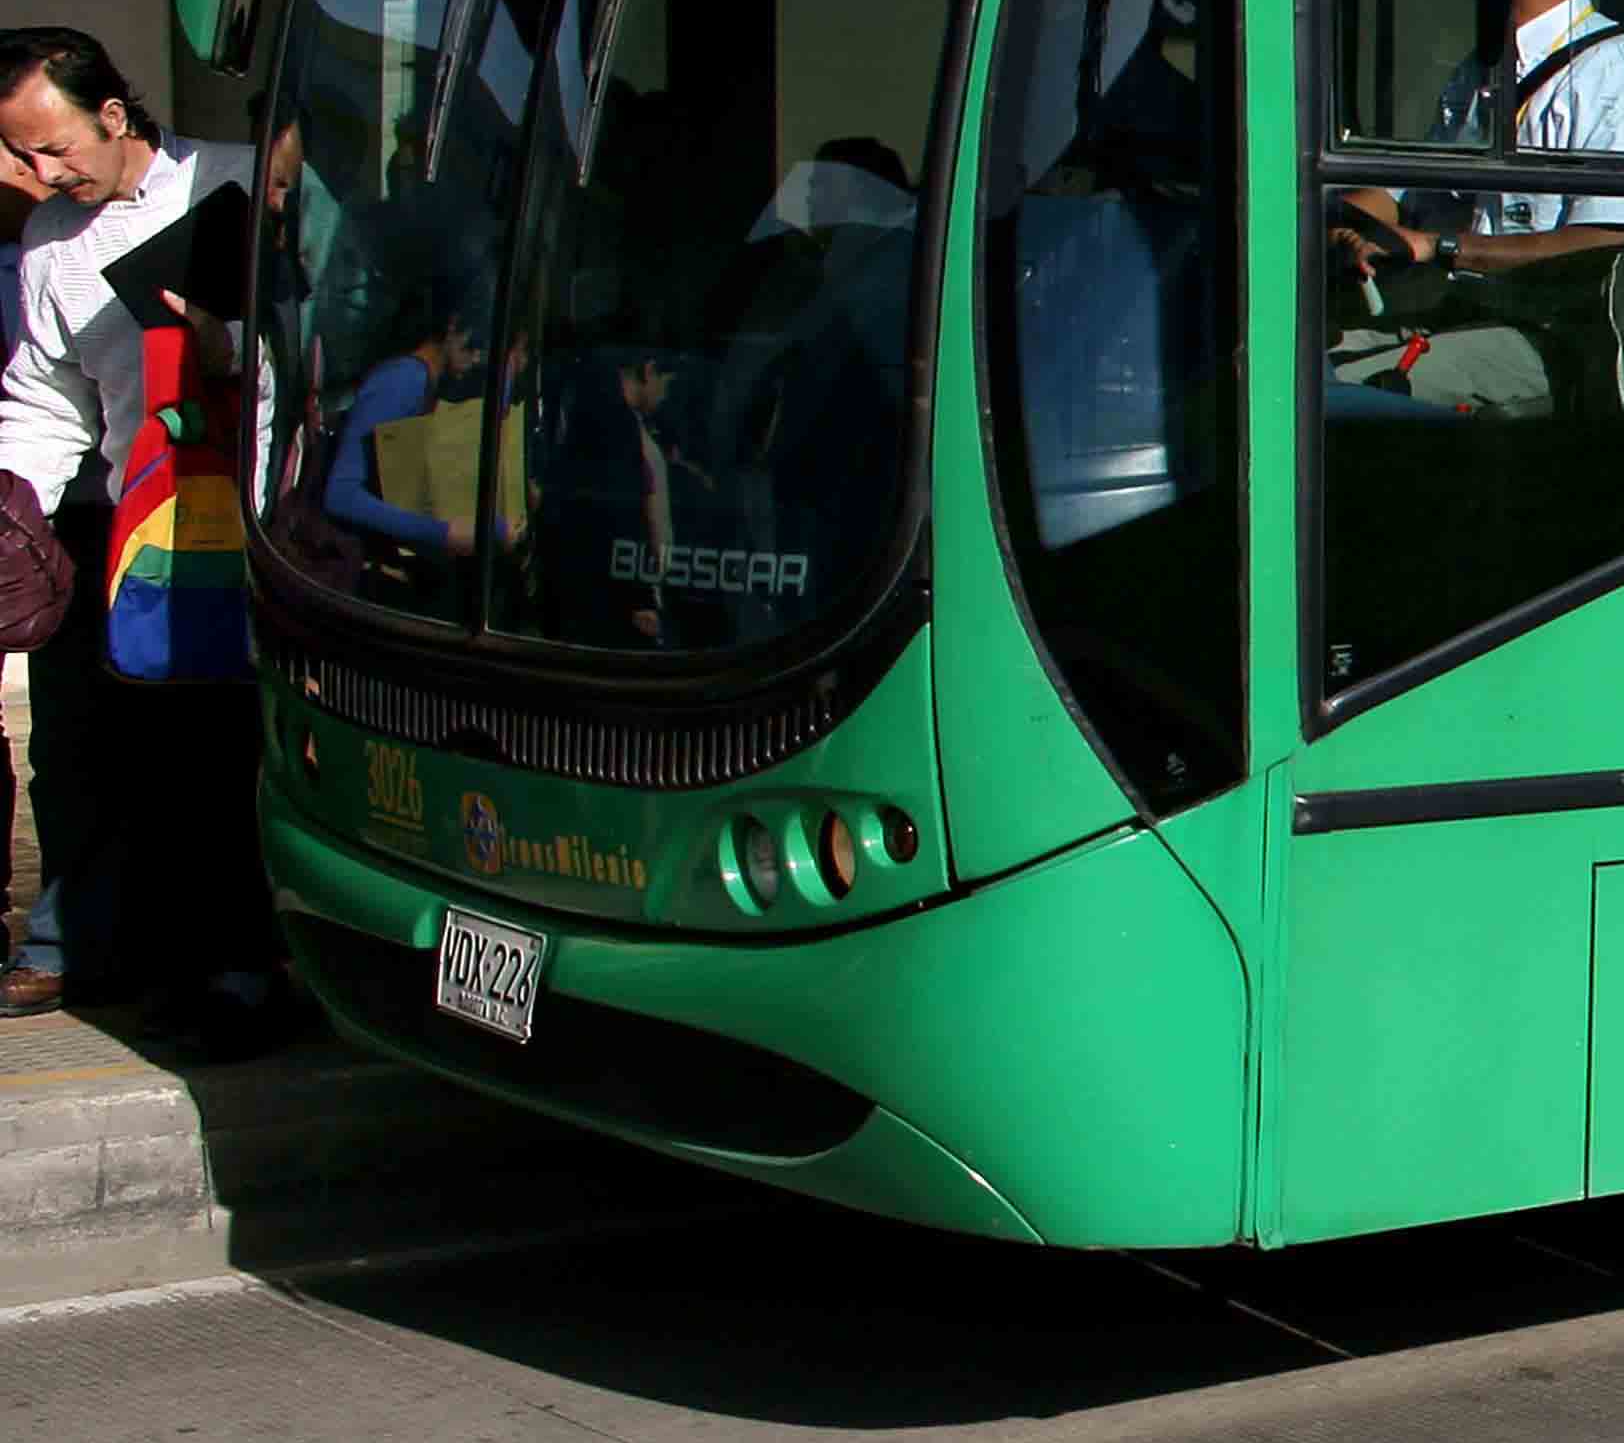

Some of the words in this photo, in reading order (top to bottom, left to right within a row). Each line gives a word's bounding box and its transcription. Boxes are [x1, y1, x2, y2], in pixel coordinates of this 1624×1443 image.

[609, 538, 809, 597] BUSSCAR
[365, 739, 424, 821] 3026
[445, 925, 489, 994] VDX
[488, 942, 538, 1008] 226
